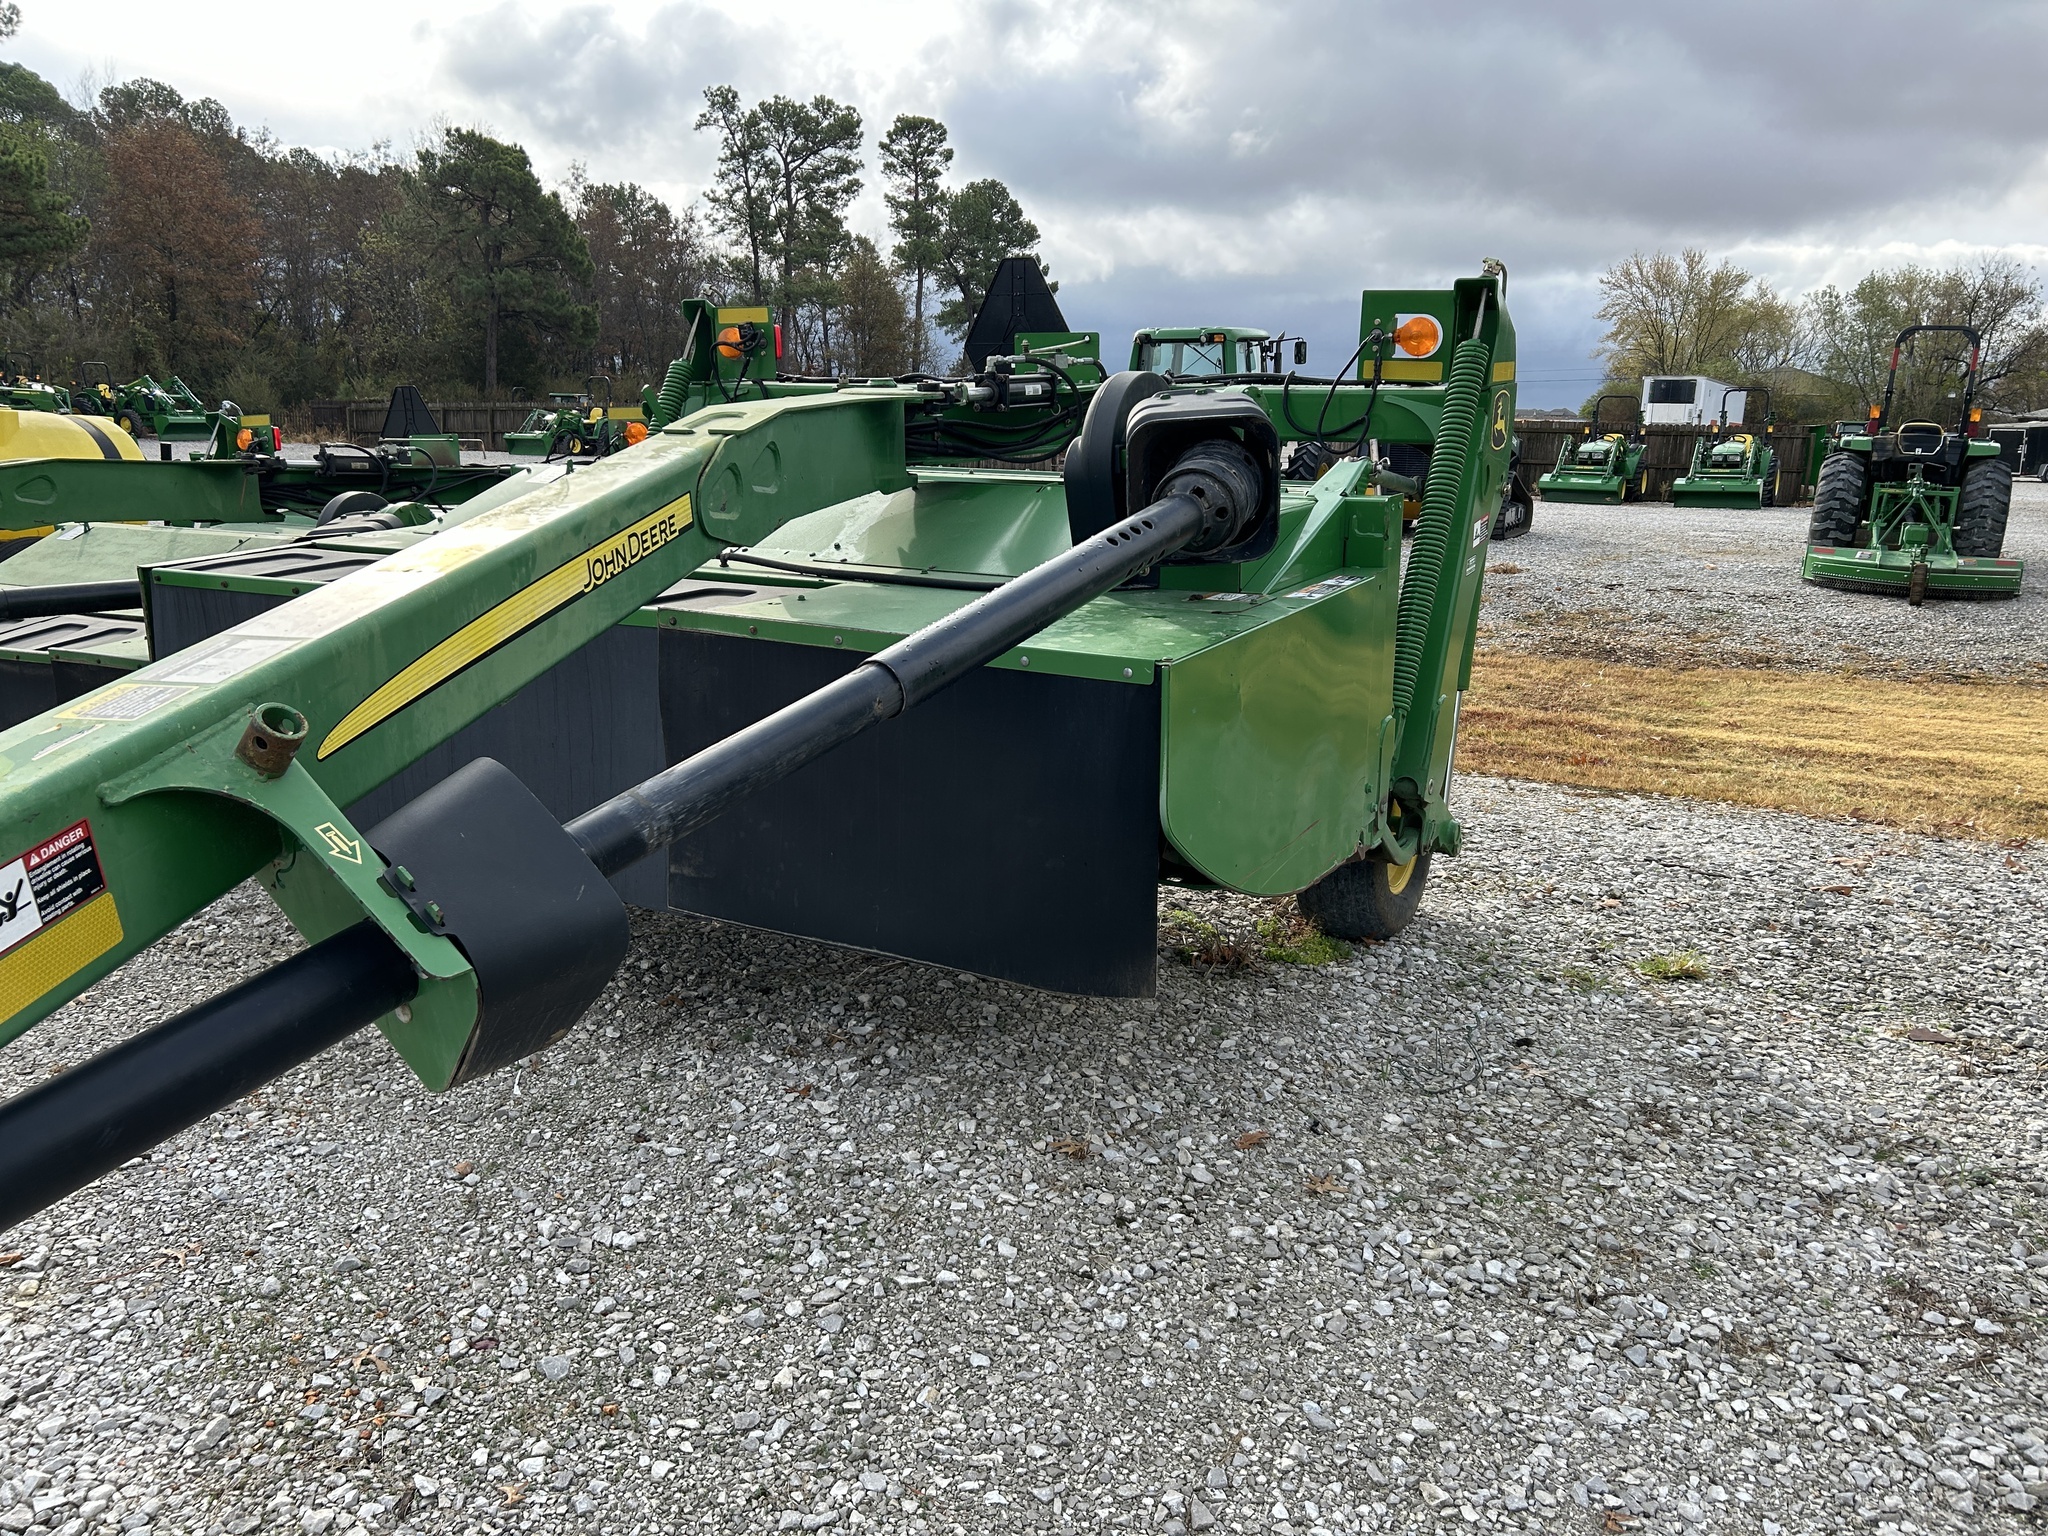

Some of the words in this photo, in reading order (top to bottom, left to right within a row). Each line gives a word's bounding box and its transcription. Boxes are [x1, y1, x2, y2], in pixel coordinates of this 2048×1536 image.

[583, 543, 629, 590] JOHN
[627, 513, 678, 561] DEERE
[40, 828, 84, 859] DANGER
